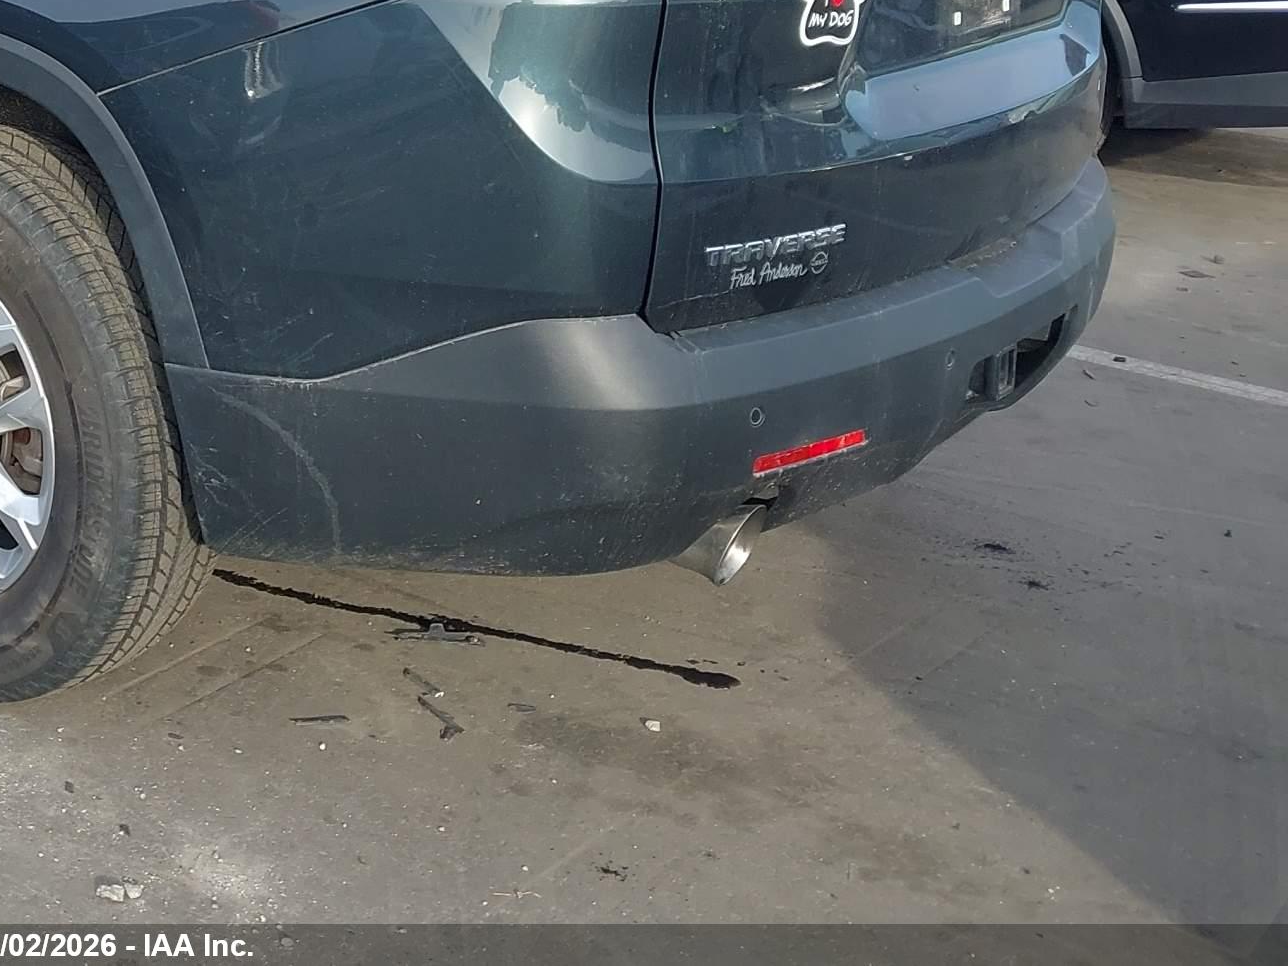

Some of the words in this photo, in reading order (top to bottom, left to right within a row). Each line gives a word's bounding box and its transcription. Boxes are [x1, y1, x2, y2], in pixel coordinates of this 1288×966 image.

[808, 11, 828, 28] MY
[828, 9, 854, 27] DOG
[705, 223, 847, 266] TRAVERSE
[730, 266, 757, 289] Fred
[759, 261, 808, 284] Anderson
